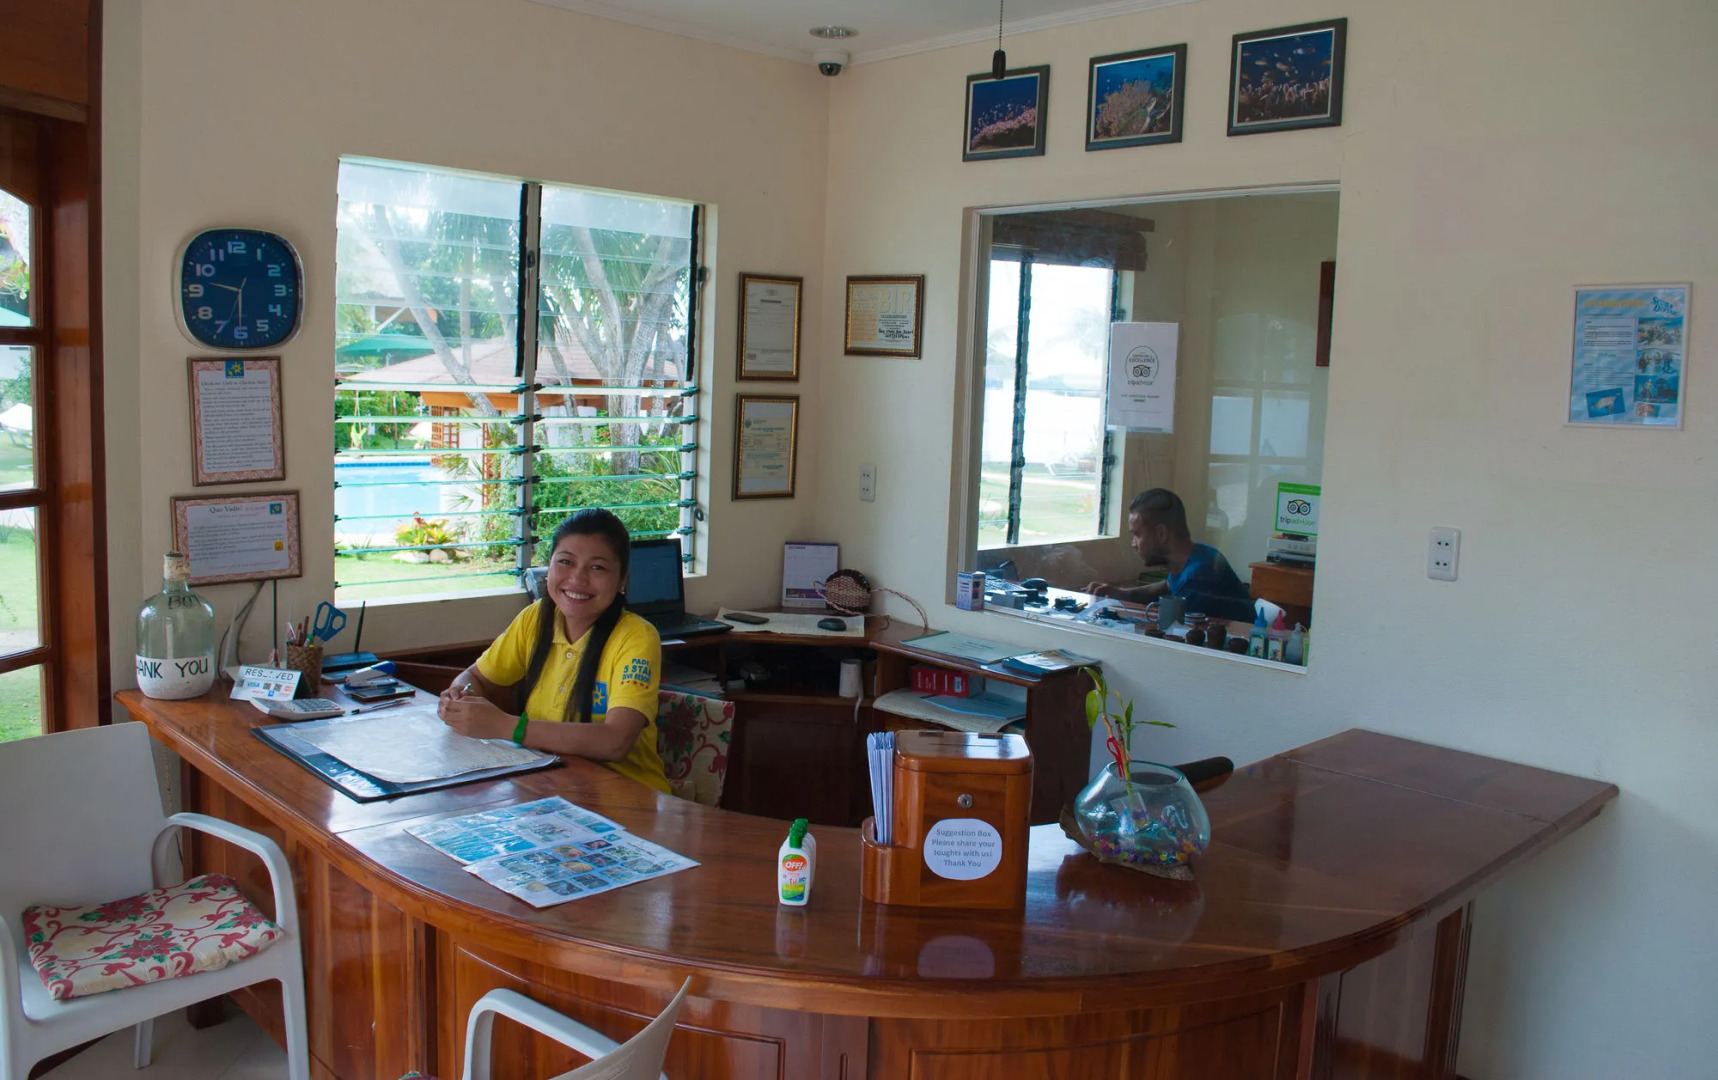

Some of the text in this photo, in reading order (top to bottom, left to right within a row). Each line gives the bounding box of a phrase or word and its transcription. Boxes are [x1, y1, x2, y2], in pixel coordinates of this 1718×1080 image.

[228, 241, 246, 254] 12
[210, 248, 224, 261] 11
[256, 248, 262, 260] 1
[196, 264, 216, 276] 10
[267, 264, 281, 276] 2
[188, 284, 204, 298] 9
[274, 284, 286, 296] 3
[198, 306, 212, 319] 8
[268, 304, 281, 316] 4
[214, 320, 229, 334] 7
[256, 320, 268, 332] 5
[234, 326, 248, 339] 6
[1280, 516, 1314, 526] tripadvisor
[136, 658, 209, 679] ANK YOU
[624, 665, 629, 673] 5
[936, 829, 976, 837] Suggestion
[785, 861, 804, 870] OFF!
